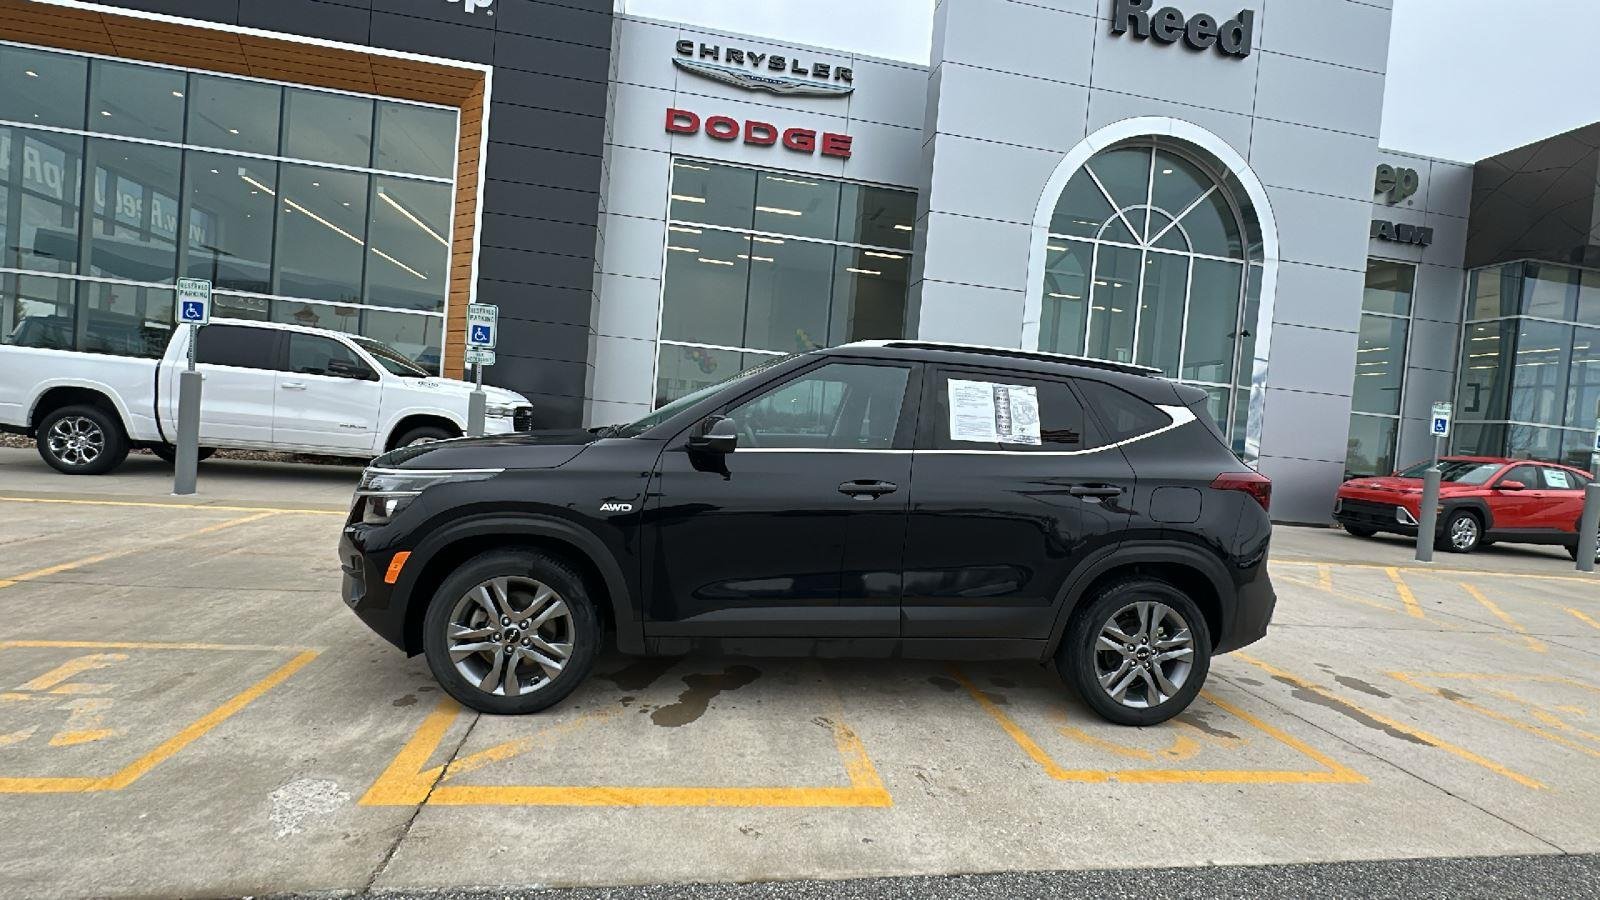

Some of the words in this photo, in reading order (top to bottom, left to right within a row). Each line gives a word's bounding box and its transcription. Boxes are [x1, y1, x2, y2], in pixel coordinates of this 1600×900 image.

[1111, 0, 1254, 59] Reed
[676, 39, 854, 82] CHRYSLER
[665, 107, 853, 158] DODGE
[1374, 163, 1419, 204] ep
[1369, 219, 1434, 247] AM
[599, 503, 633, 512] AWD
